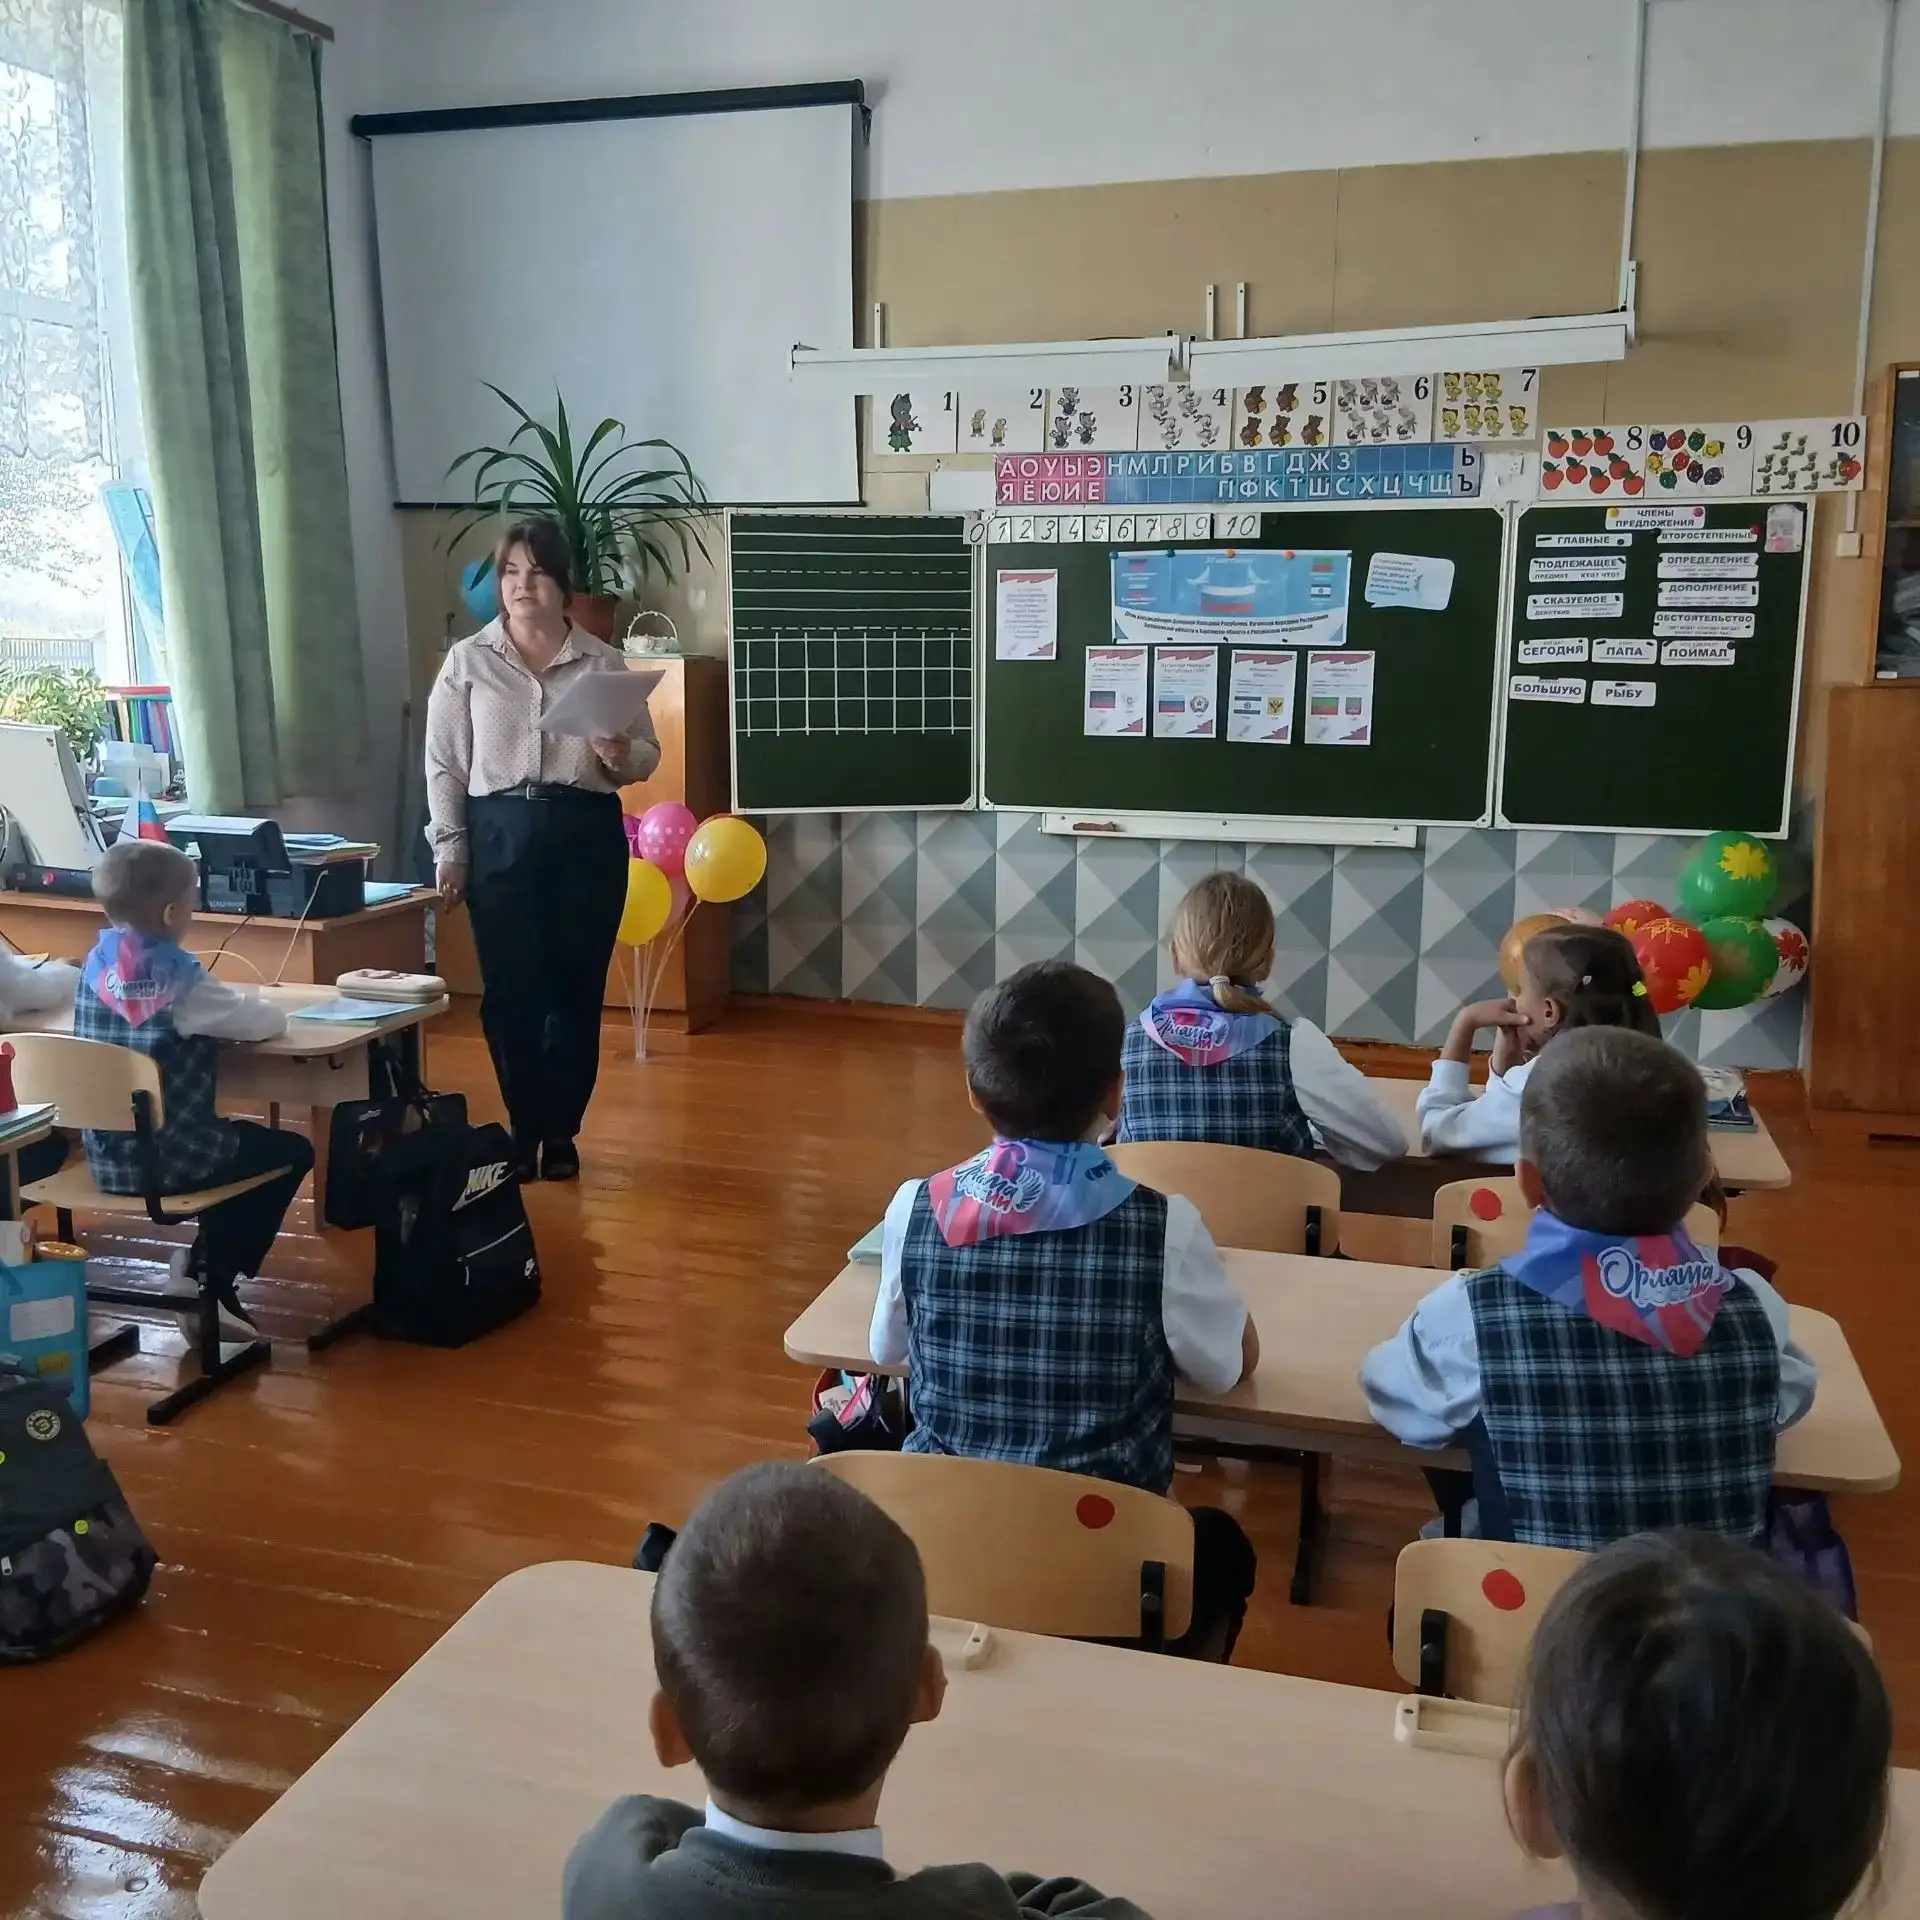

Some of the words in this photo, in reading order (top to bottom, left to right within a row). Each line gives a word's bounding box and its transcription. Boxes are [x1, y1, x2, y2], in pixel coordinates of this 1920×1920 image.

[943, 391, 953, 411] 1
[1029, 388, 1043, 410] 2
[1119, 384, 1133, 407] 3
[1212, 388, 1227, 407] 4
[1313, 381, 1328, 405] 5
[1414, 376, 1430, 400] 6
[1521, 369, 1537, 392] 7
[1626, 425, 1643, 450] 8
[1736, 425, 1752, 449] 9
[1831, 422, 1861, 447] 10
[1637, 509, 1674, 517] ЧЛЕНЫ
[1615, 519, 1695, 528] ПРЕДЛОЖЕНИЯ
[970, 523, 985, 543] 0
[999, 521, 1008, 541] 1
[1019, 519, 1032, 540] 2
[1041, 520, 1056, 540] 3
[1069, 519, 1079, 540] 4
[1092, 518, 1106, 540] 5
[1117, 518, 1133, 539] 6
[1146, 518, 1158, 539] 7
[1166, 517, 1182, 538] 8
[1192, 516, 1208, 537] 9
[1227, 515, 1256, 536] 10
[1557, 536, 1610, 545] ГЛАВНЫЕ
[1538, 558, 1617, 569] ПОДЛЕЖАЩЕЕ
[1667, 555, 1751, 565] ОПРЕДЕЛЕНИЕ
[1668, 583, 1749, 593] ДОПОЛНЕНИЕ
[1543, 595, 1607, 605] СКАЗУЕМОЕ
[1656, 614, 1753, 622] ОБСТОЯТЕЛЬСТВО
[1523, 645, 1584, 656] СЕГОДНЯ
[1606, 646, 1643, 656] ПАПА
[1514, 683, 1582, 696] БОЛЬШУЮ
[1605, 689, 1643, 698] РЫБУ
[465, 1161, 509, 1196] NIKE
